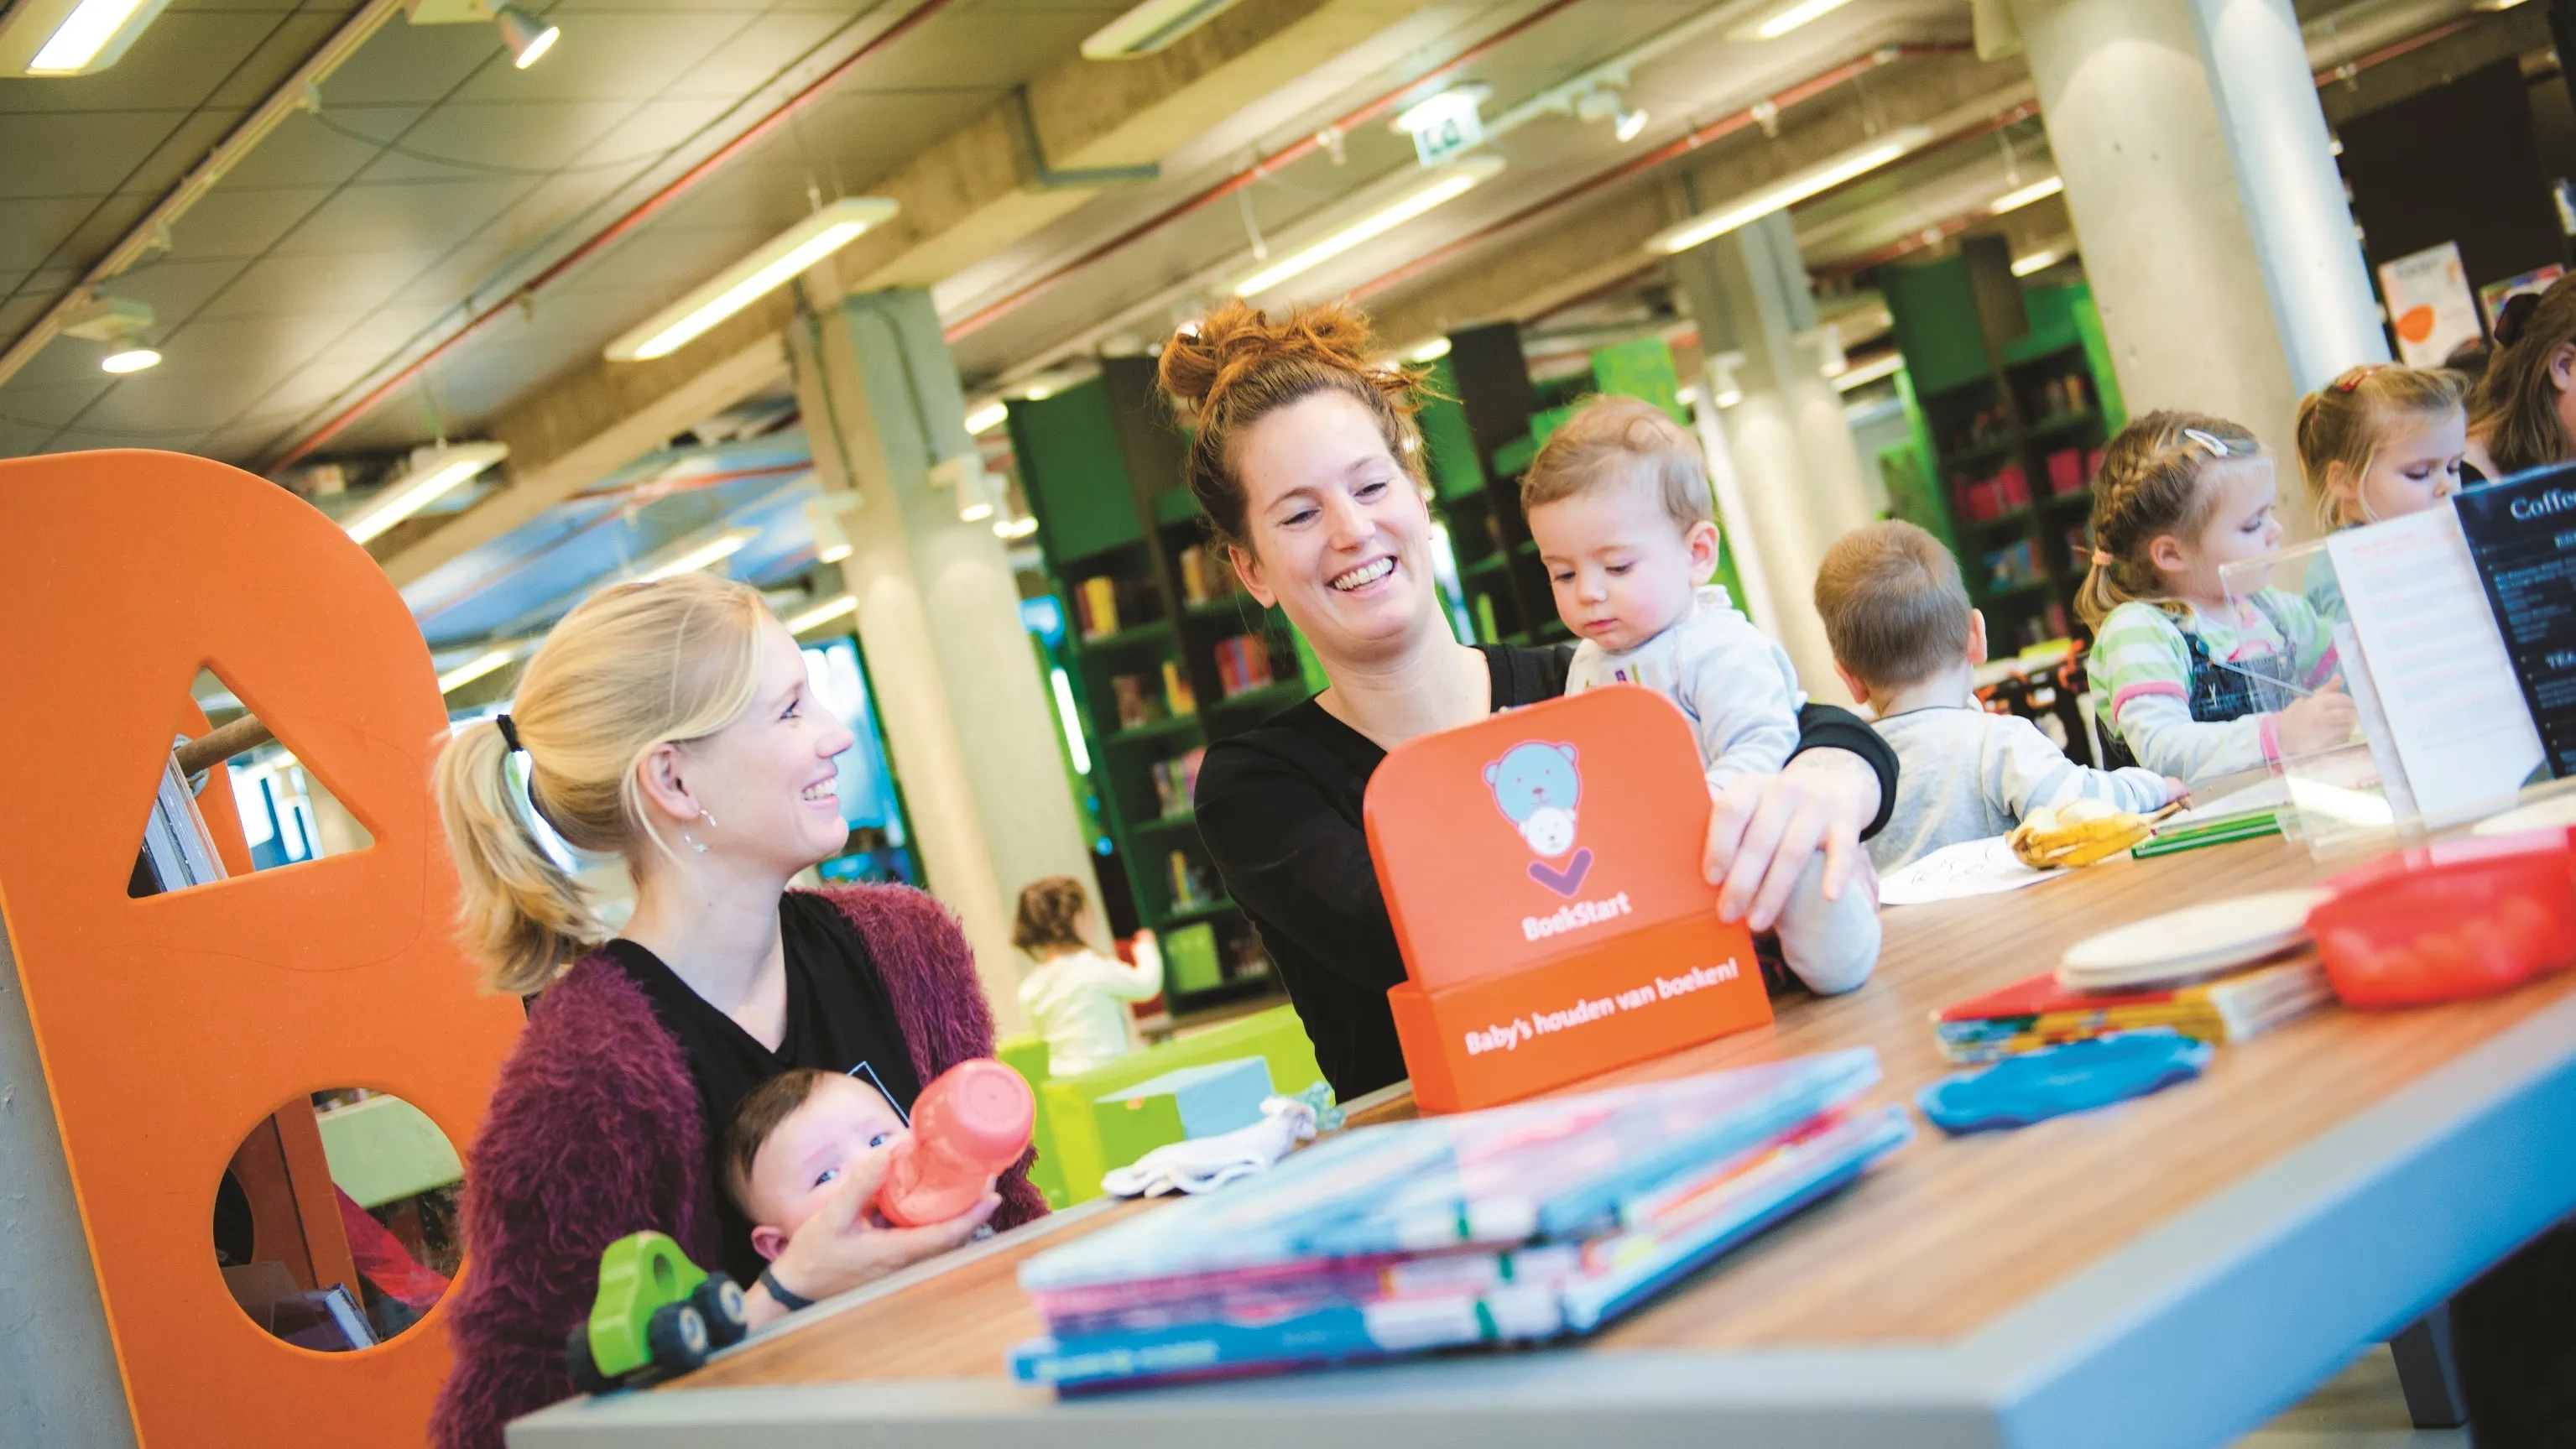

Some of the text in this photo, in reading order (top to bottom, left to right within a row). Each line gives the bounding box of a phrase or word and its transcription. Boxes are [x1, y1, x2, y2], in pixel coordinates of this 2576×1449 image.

[2510, 488, 2576, 520] Coffe
[1521, 891, 1632, 941] BoekStart
[1465, 956, 1739, 1055] Baby's houden van boeken!
